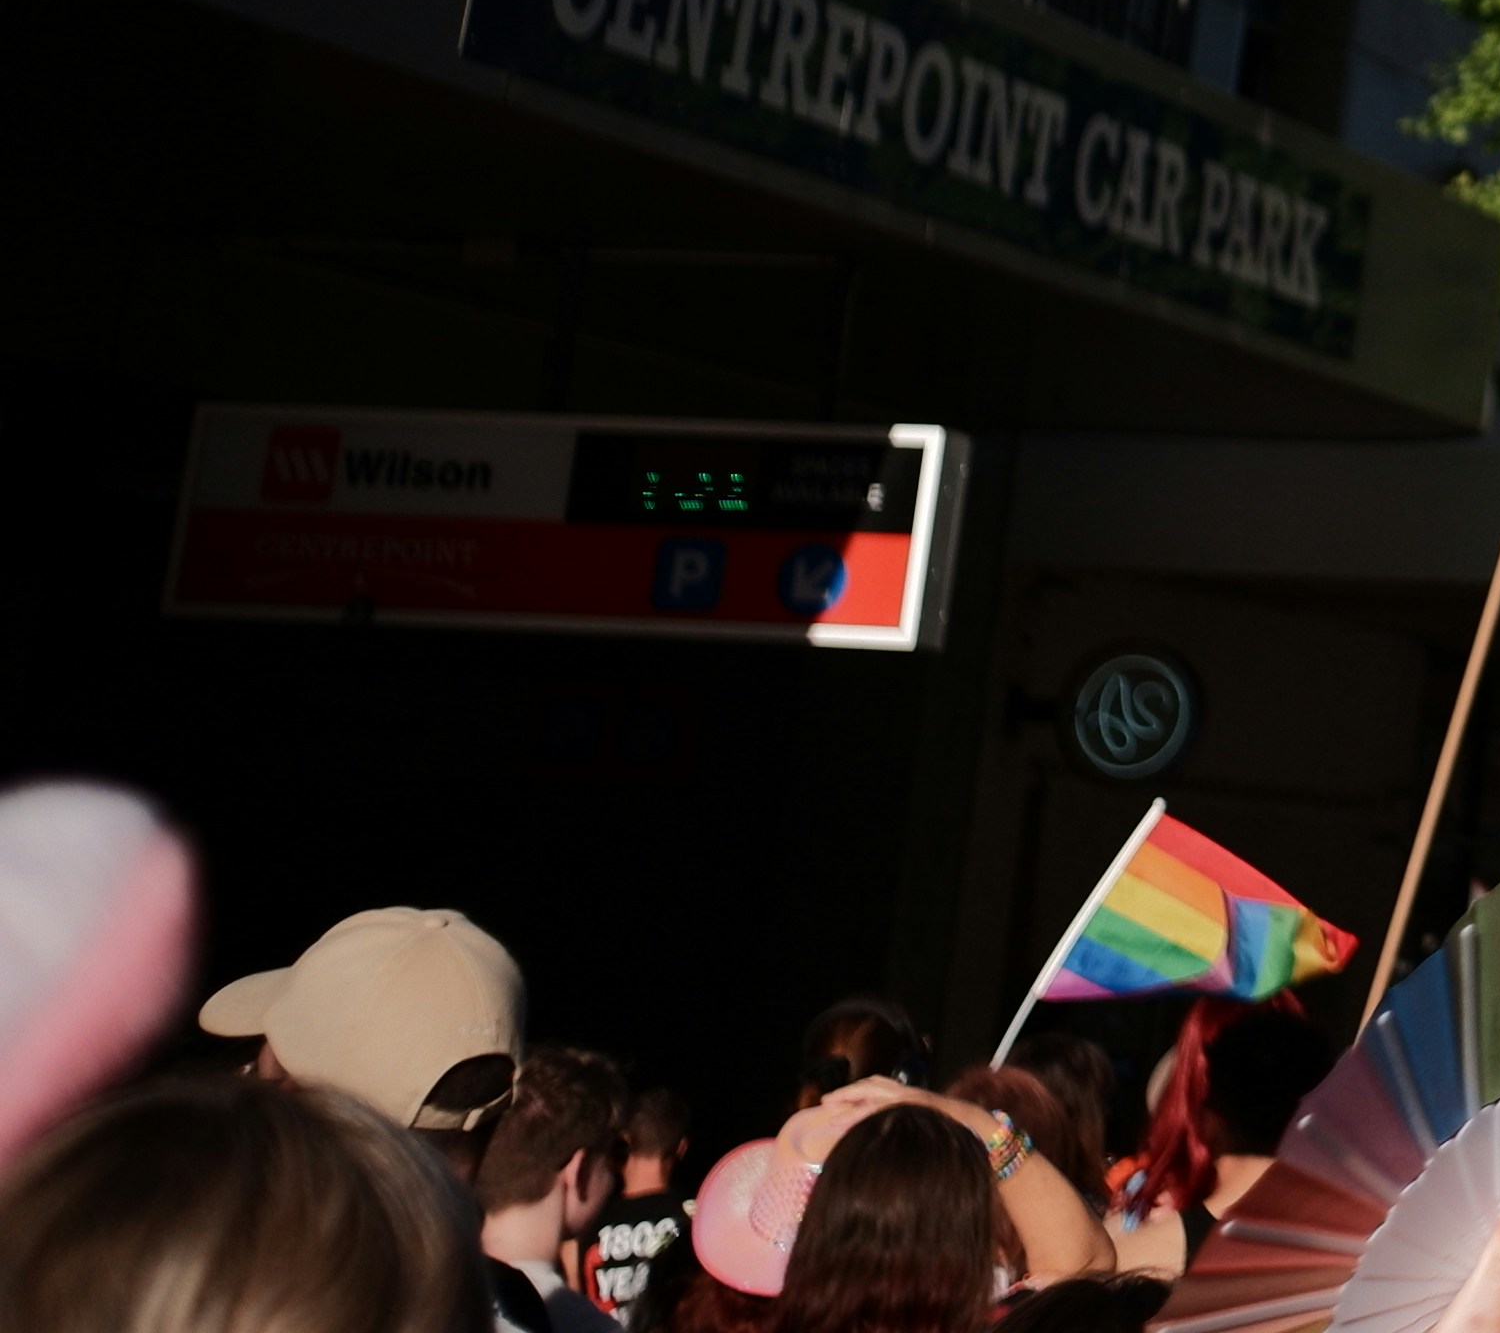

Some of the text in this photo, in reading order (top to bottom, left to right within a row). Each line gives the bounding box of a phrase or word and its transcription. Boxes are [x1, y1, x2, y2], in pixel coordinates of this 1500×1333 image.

[1074, 110, 1190, 257] CAR
[1196, 156, 1332, 308] PARK
[344, 447, 493, 491] Wilson
